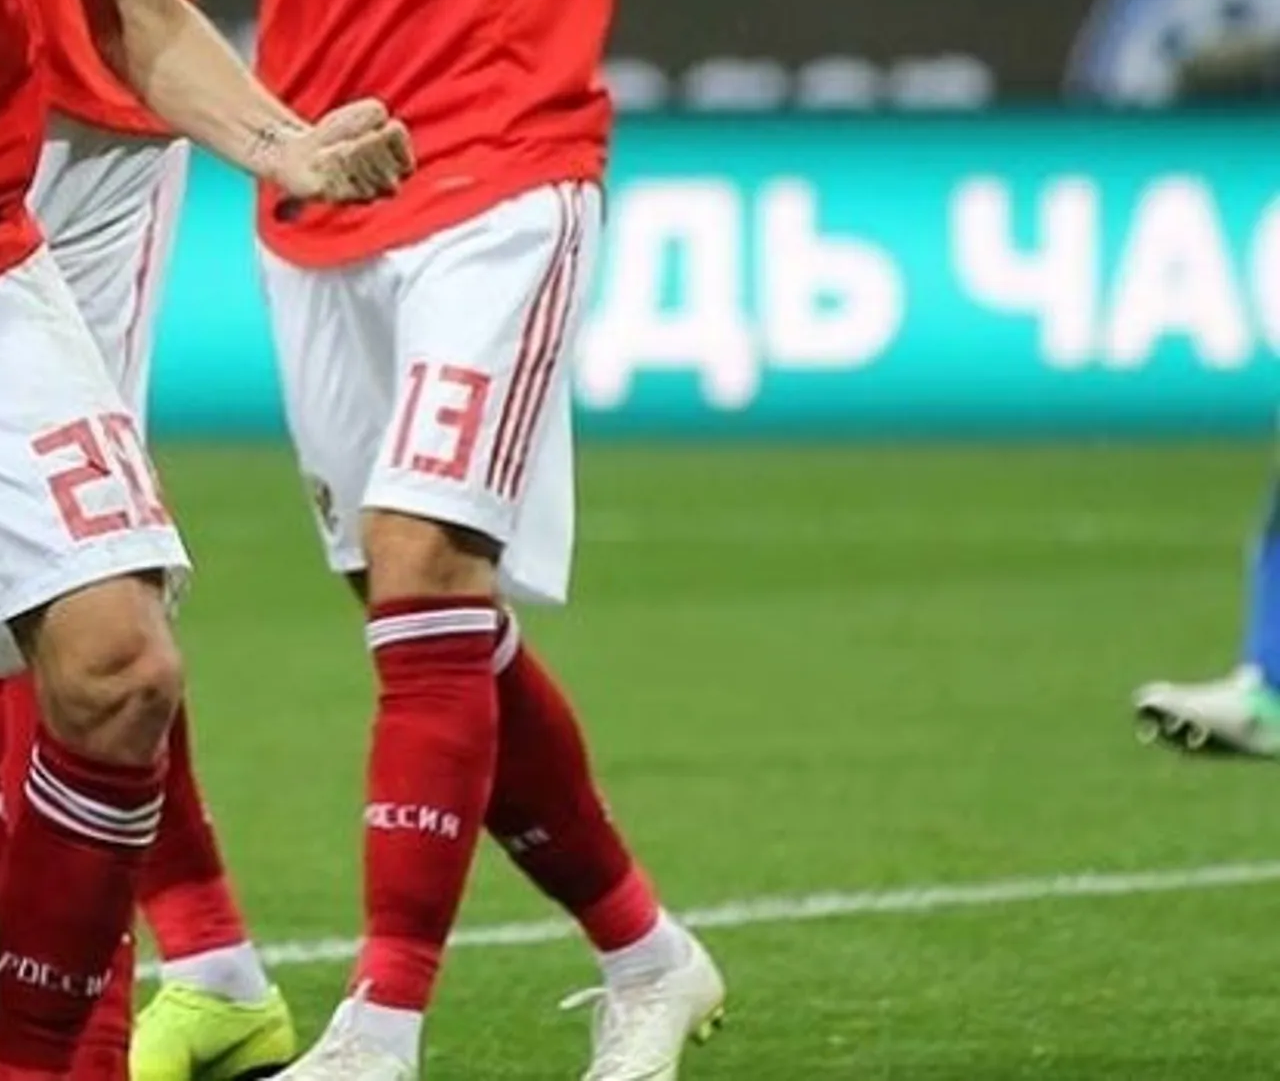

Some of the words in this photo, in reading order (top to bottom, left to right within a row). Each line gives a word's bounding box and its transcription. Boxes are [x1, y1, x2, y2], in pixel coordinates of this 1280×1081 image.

[952, 175, 1280, 369] ЧА
[30, 412, 167, 542] 20
[390, 363, 491, 482] 13
